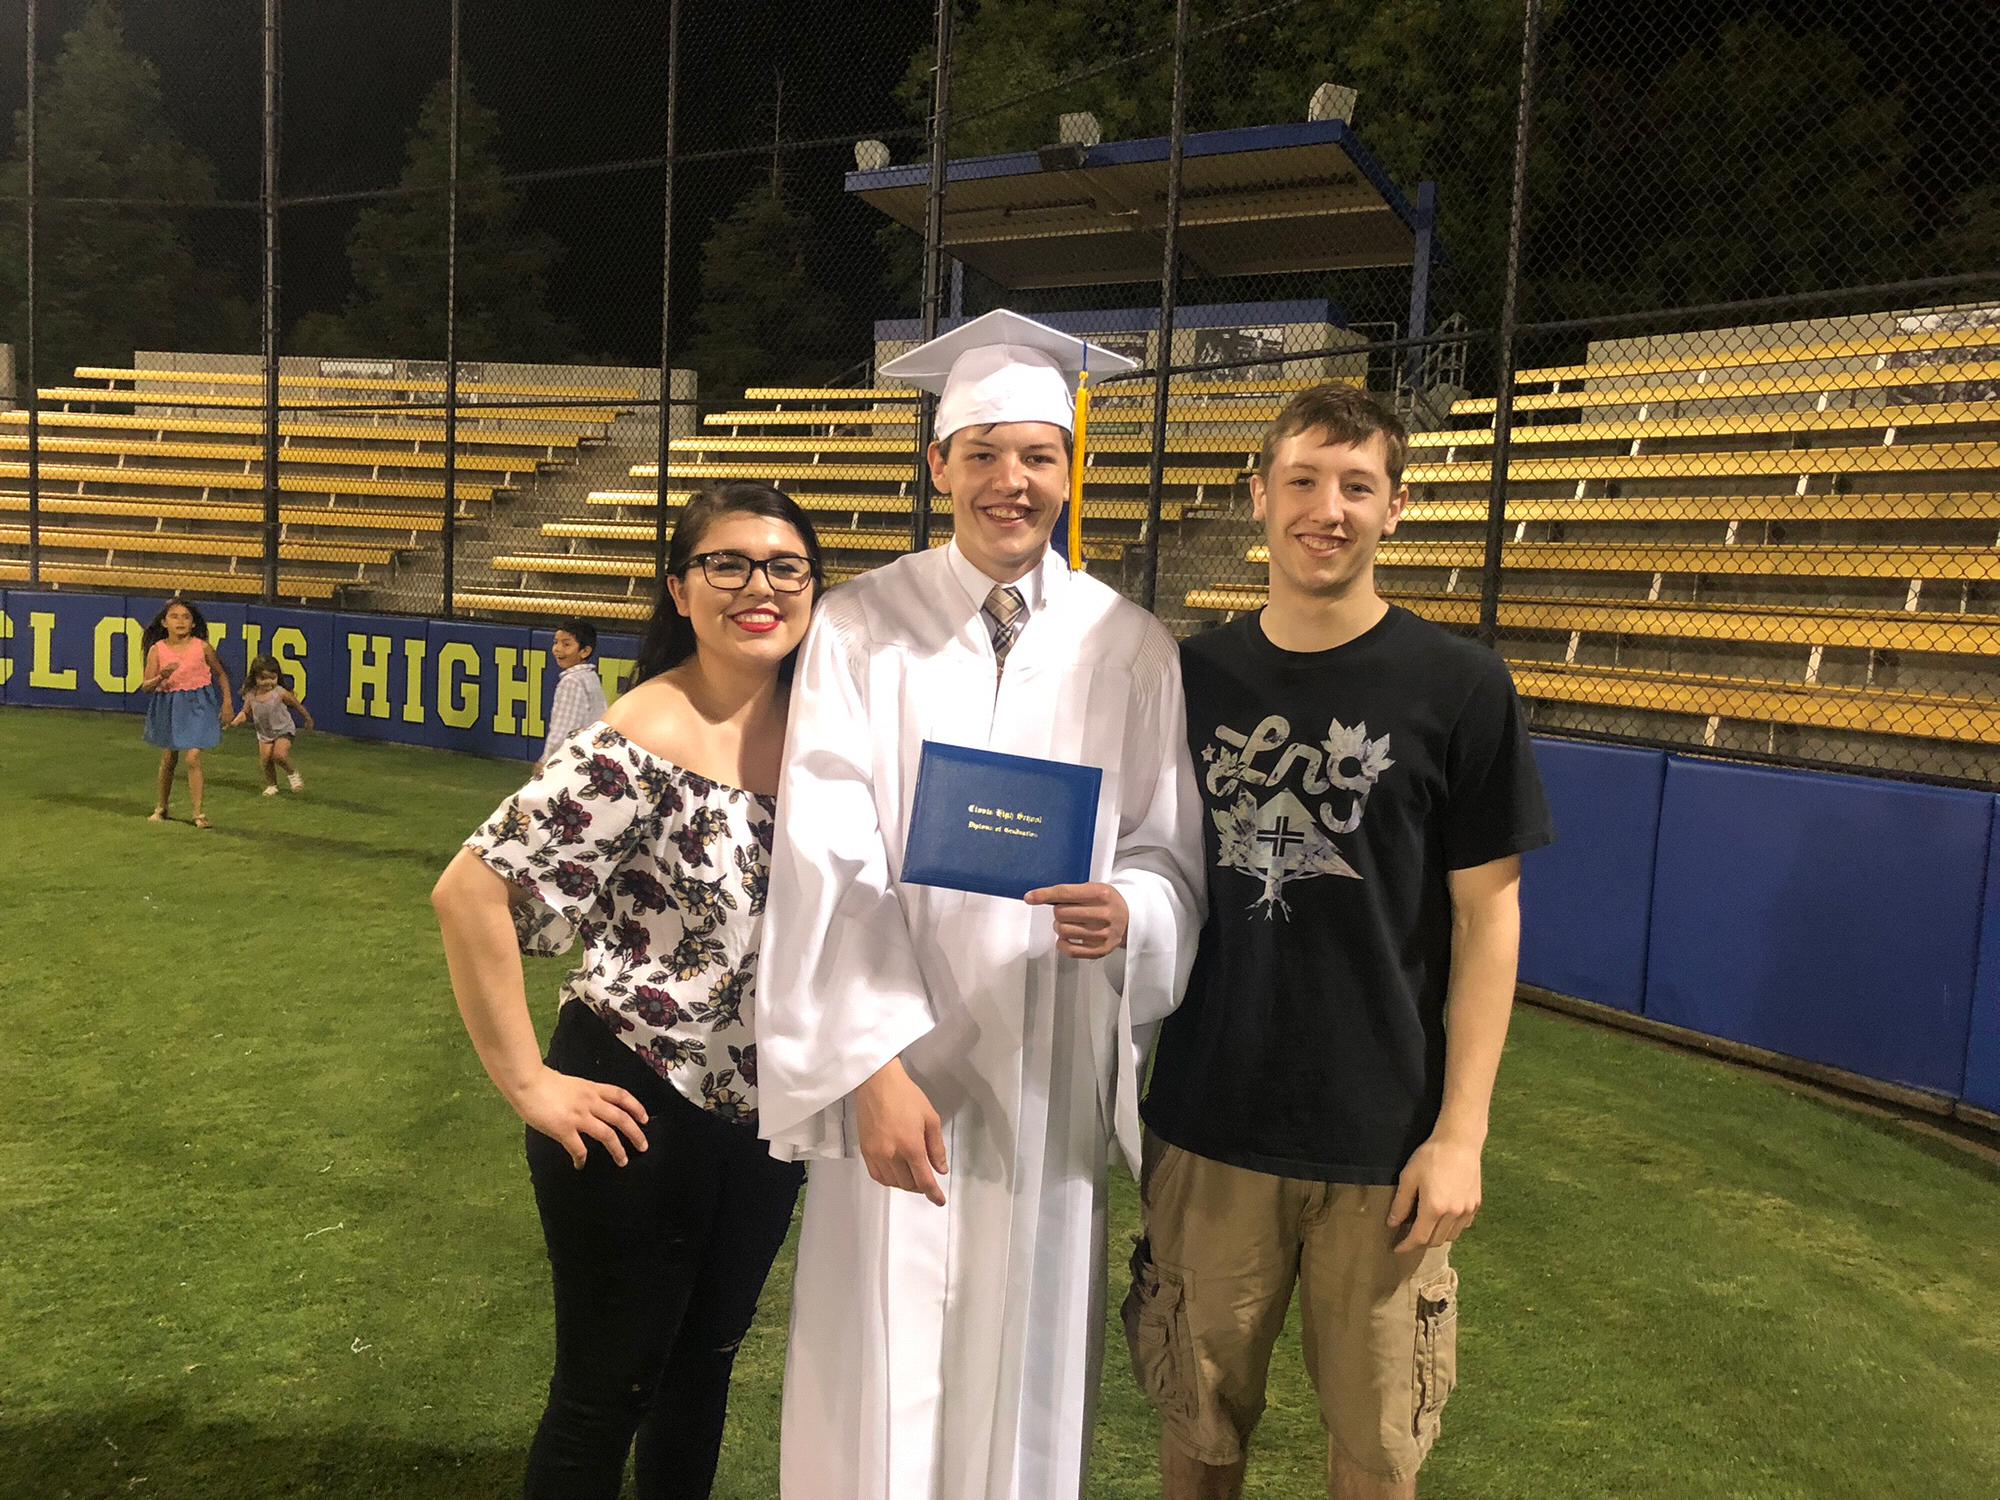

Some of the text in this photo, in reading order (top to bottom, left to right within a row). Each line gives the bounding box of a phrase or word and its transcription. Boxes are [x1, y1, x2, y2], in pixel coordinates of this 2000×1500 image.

[0, 610, 307, 705] LOIS
[346, 633, 546, 737] HIGH
[967, 804, 1043, 824] Clovis High School
[968, 821, 993, 831] Diploma
[1003, 827, 1039, 839] Graduation
